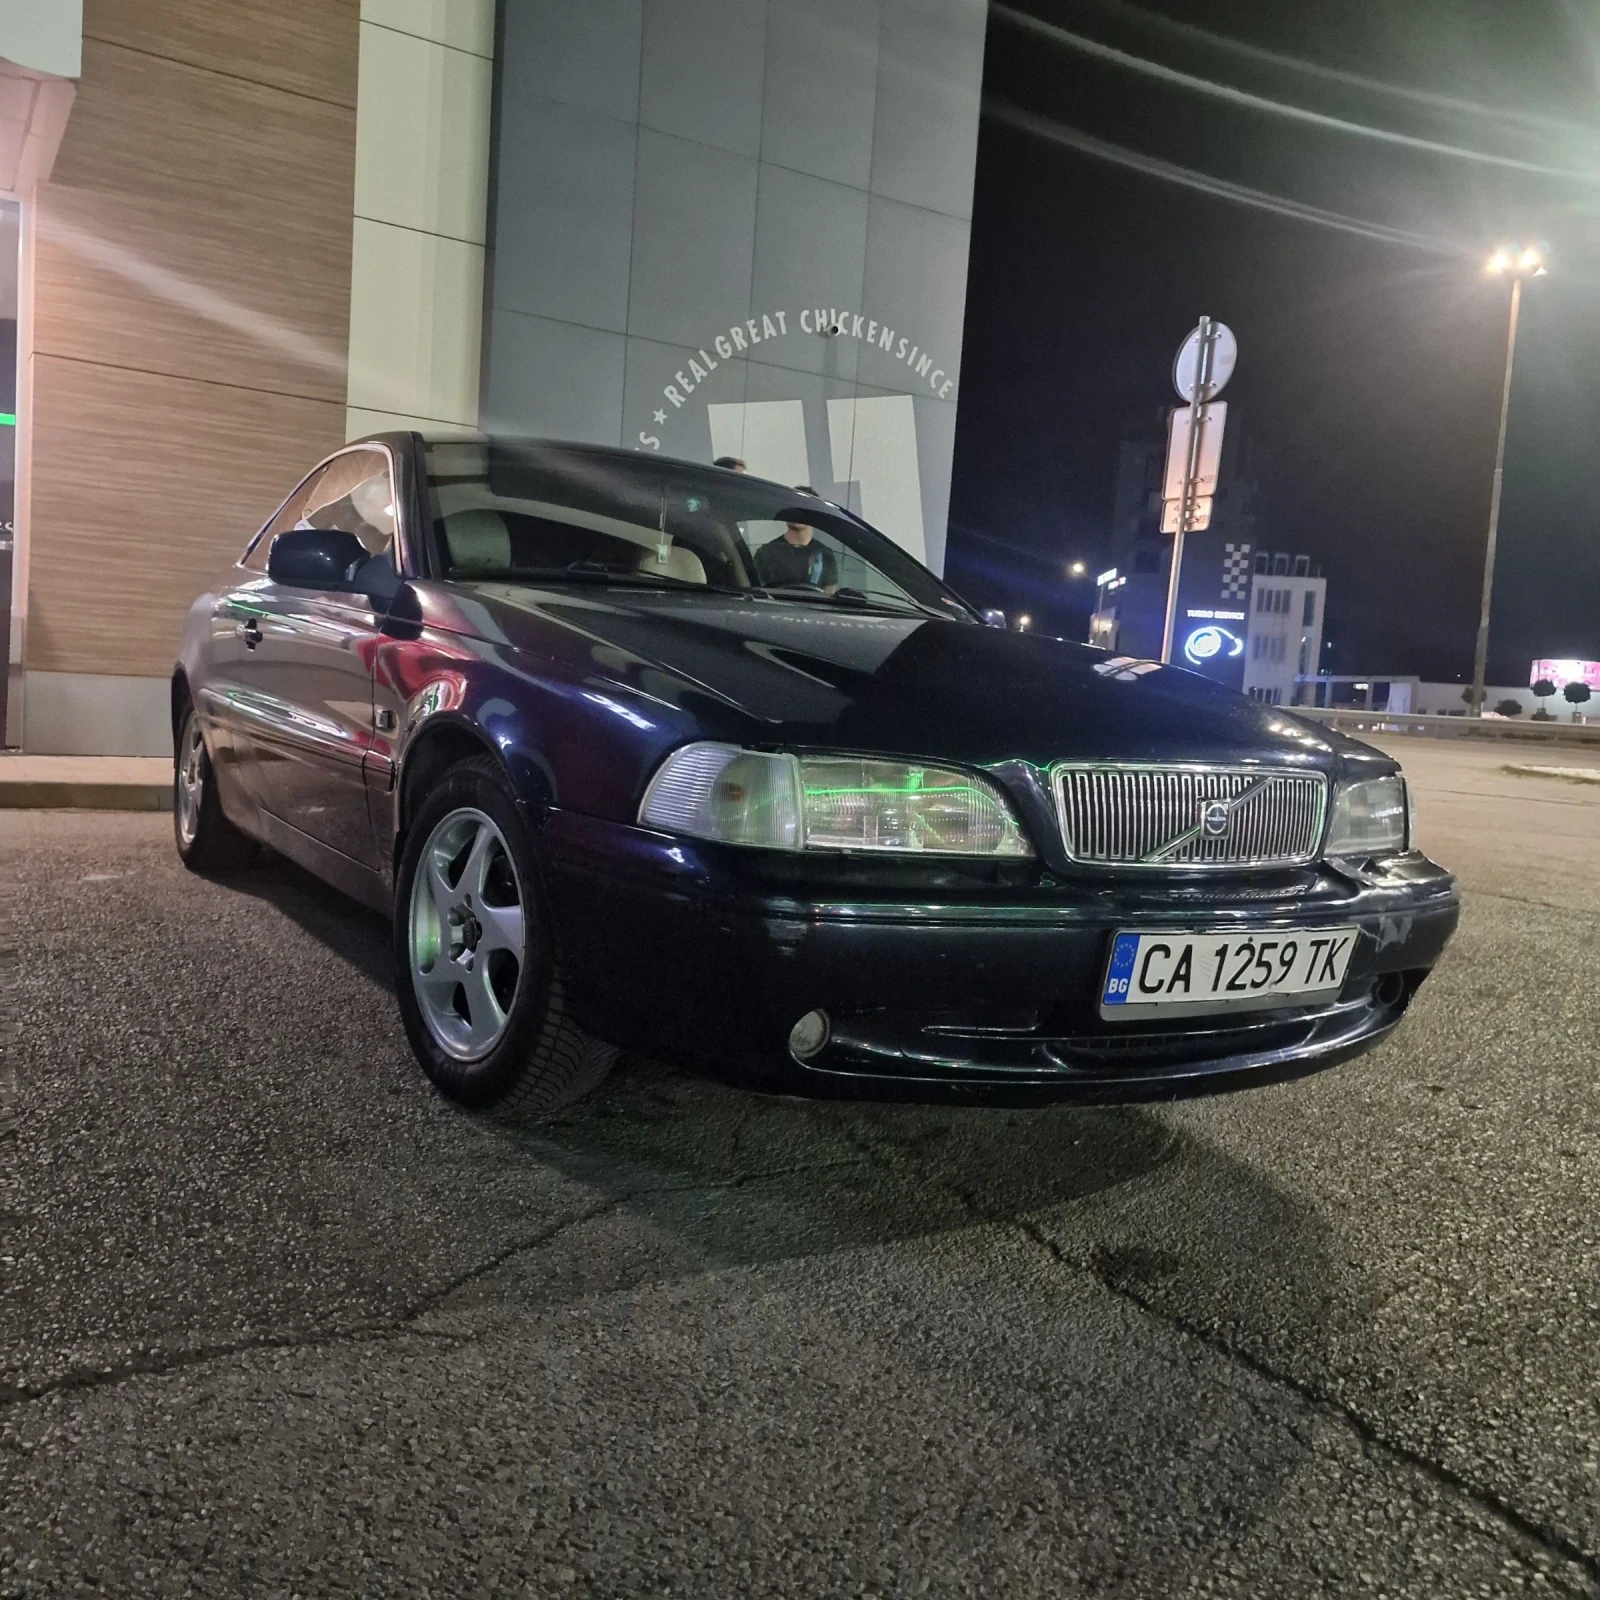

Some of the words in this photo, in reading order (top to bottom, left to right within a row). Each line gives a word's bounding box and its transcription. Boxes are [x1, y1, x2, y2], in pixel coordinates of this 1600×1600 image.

[714, 311, 787, 359] GREAT
[895, 337, 953, 399] SINCE
[1107, 977, 1128, 994] BG
[1138, 943, 1195, 995] CA
[1210, 941, 1299, 993] 1259
[1303, 936, 1350, 985] TK
